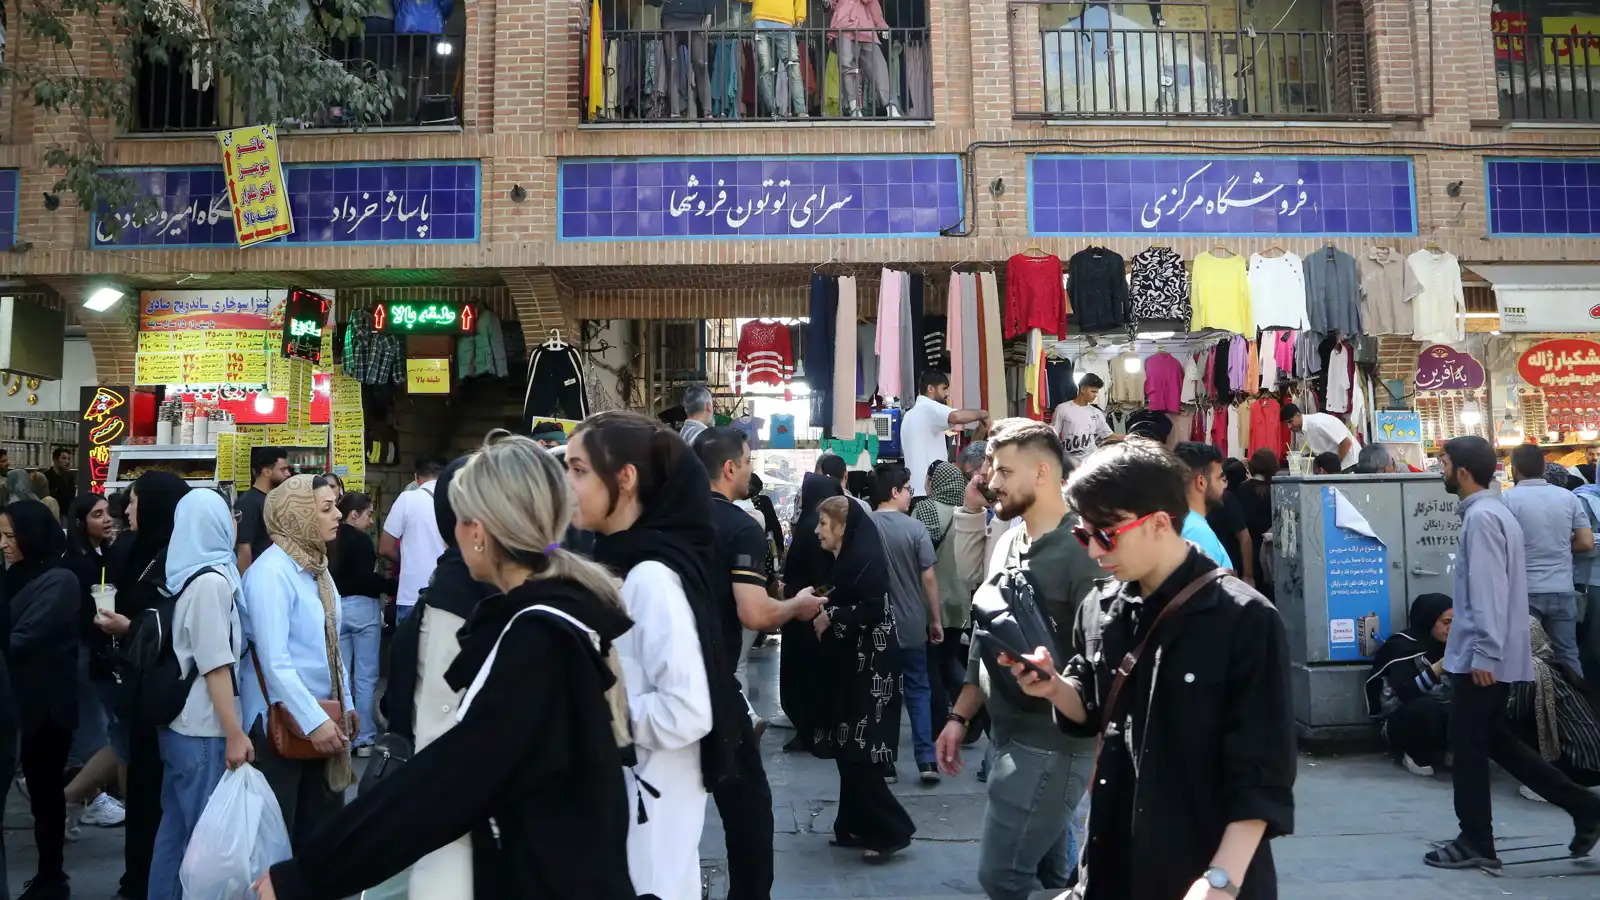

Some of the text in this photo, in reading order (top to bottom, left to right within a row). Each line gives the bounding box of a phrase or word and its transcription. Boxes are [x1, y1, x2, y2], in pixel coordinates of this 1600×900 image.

[238, 157, 270, 181] شومیز
[240, 184, 258, 207] شلوار
[669, 174, 852, 228] سرای توتون فروشها
[1140, 162, 1307, 229] فروشگاه مرکزی
[243, 209, 256, 228] بالا
[331, 190, 429, 238] پاساژ خرداد
[146, 296, 172, 315] صادق
[173, 296, 209, 315] ساندویچ
[211, 297, 249, 314] سوخاری
[391, 305, 456, 328] طبقه بالا
[227, 352, 243, 362] ۱۹۵
[1528, 348, 1600, 371] شکبار ژاله
[1416, 359, 1467, 389] به آفرین
